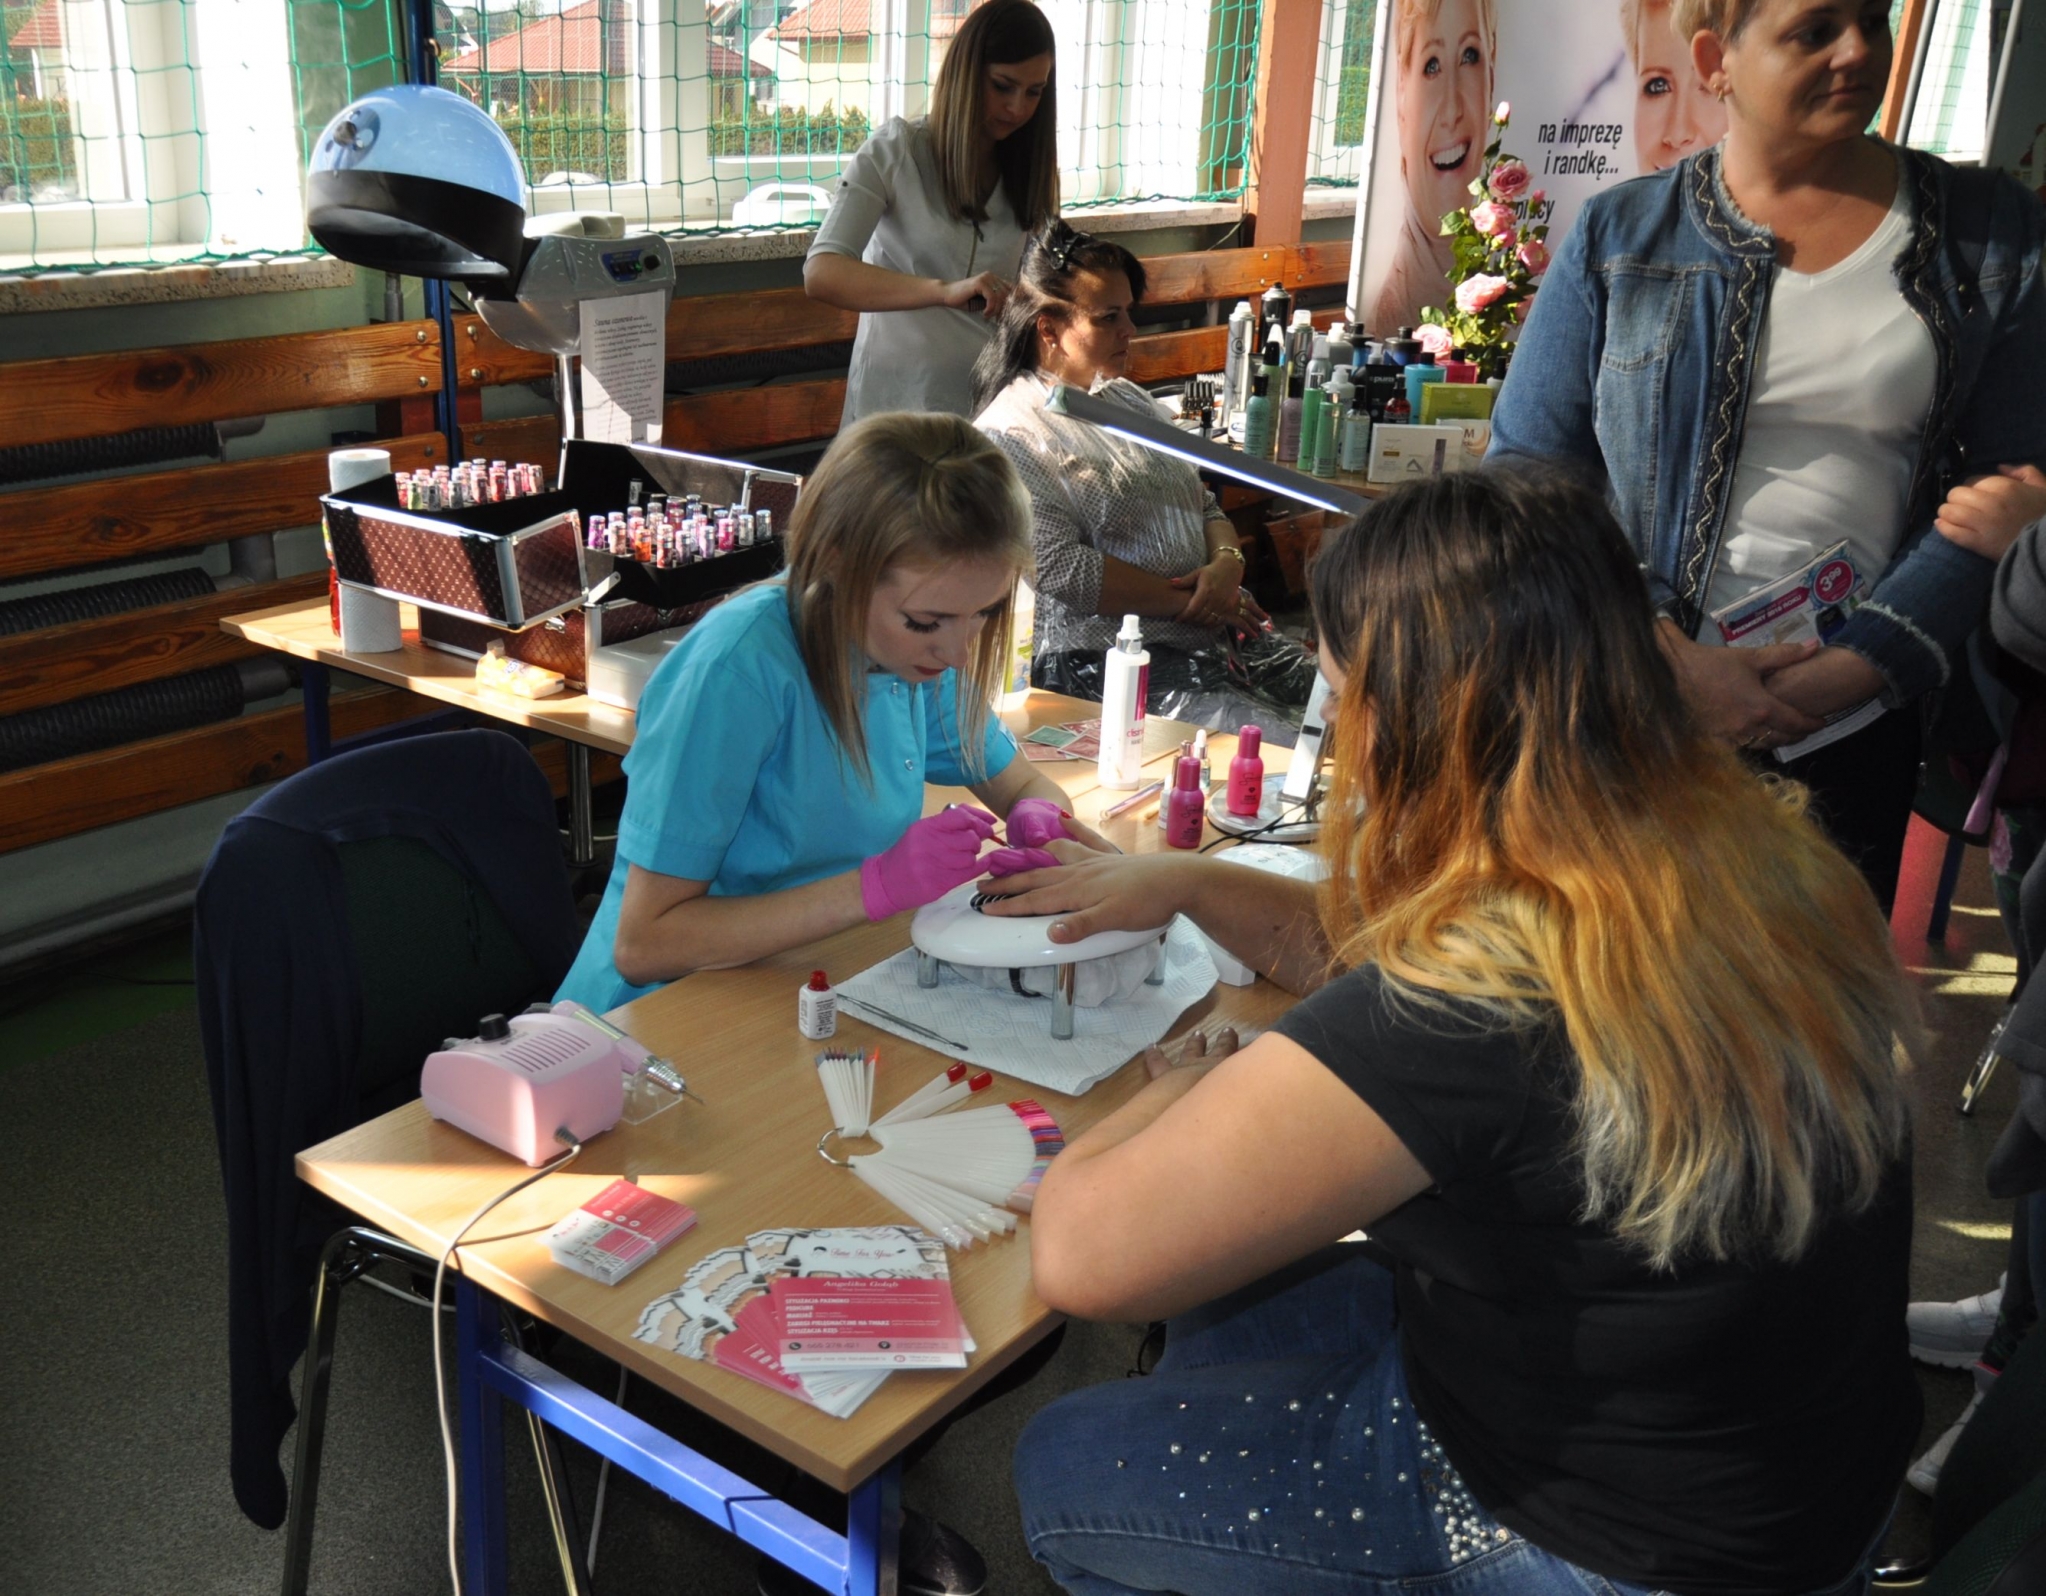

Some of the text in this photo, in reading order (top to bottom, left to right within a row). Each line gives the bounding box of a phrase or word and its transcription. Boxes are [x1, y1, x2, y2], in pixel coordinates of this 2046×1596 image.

[1538, 118, 1623, 150] na imprezę
[1544, 150, 1619, 181] i randkę...
[855, 1247, 869, 1257] For
[823, 1280, 866, 1288] Angelika
